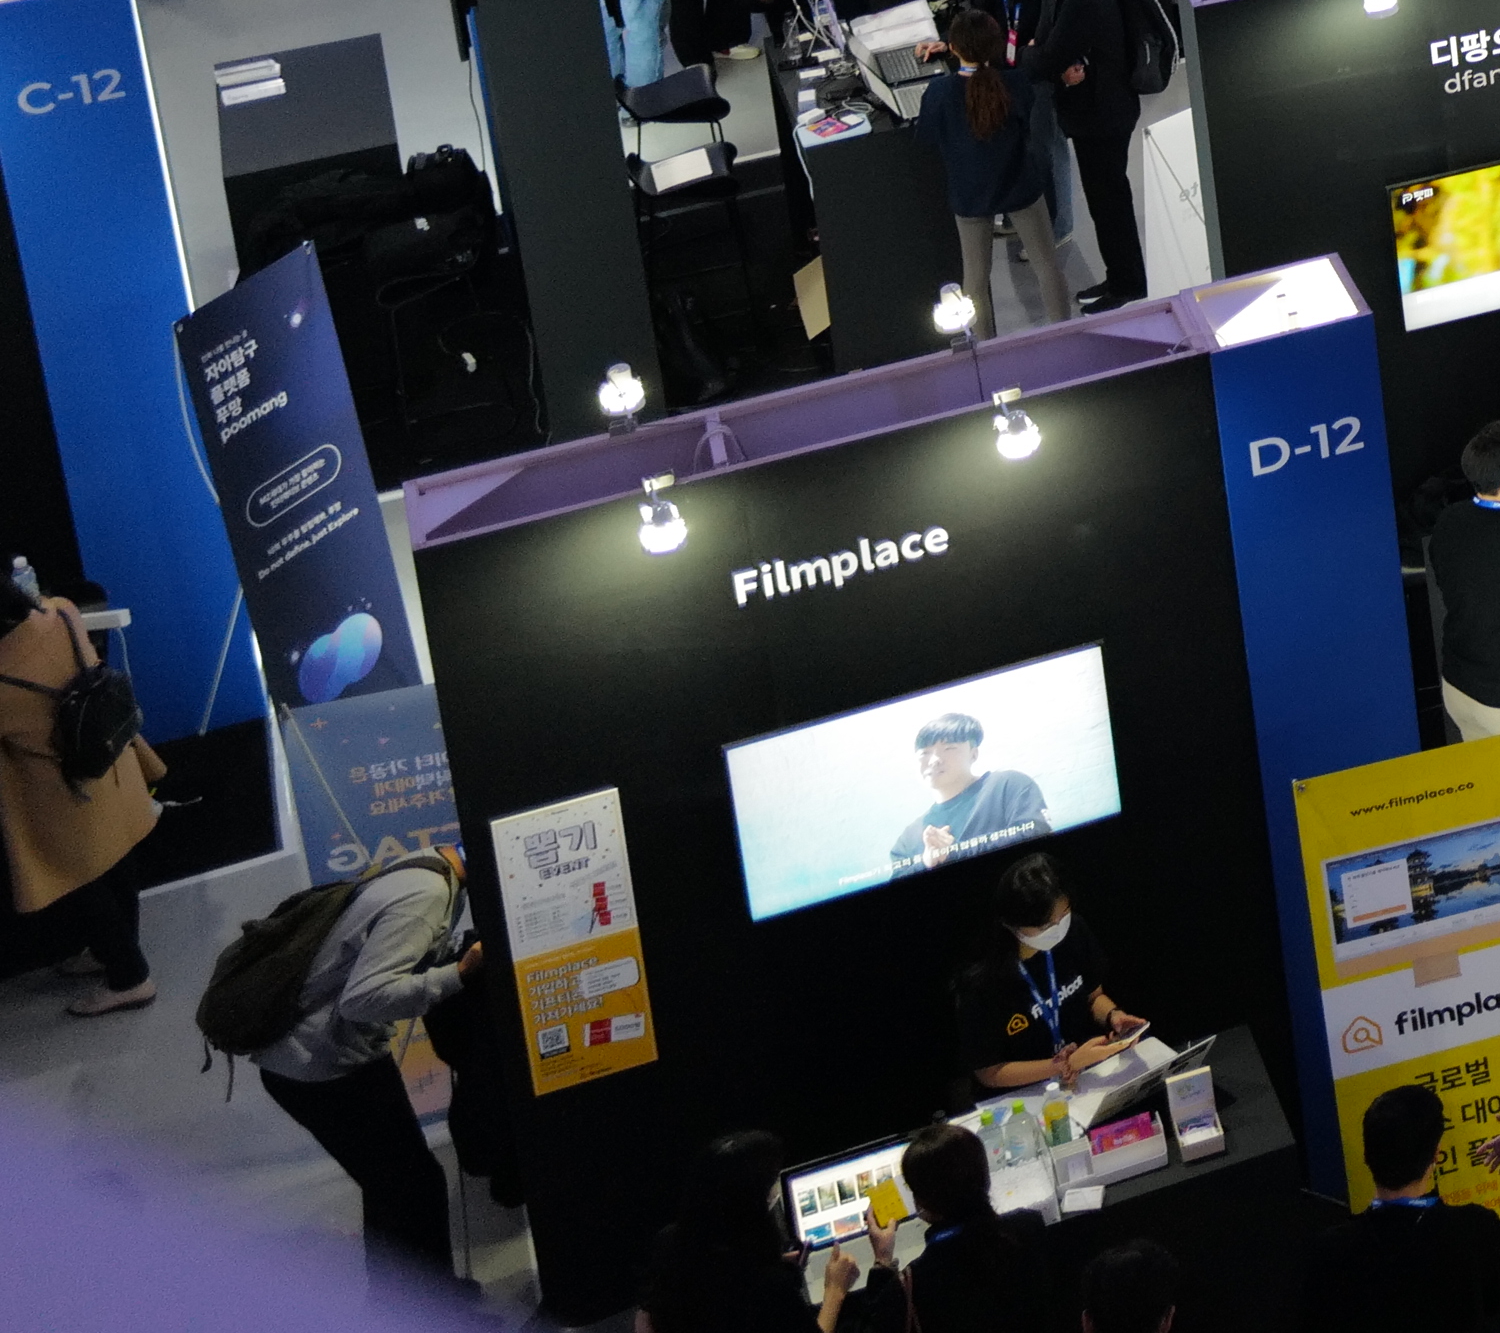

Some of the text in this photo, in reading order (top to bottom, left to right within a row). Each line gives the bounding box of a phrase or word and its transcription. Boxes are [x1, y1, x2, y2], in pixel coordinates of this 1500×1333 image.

[17, 68, 127, 115] C-12
[204, 337, 259, 383] 자아탐구
[220, 390, 289, 446] poomang
[1247, 416, 1366, 477] D-12
[732, 525, 951, 608] Filmplace
[1350, 781, 1475, 819] www.filmplace.co
[523, 820, 598, 870] 뽑기
[539, 856, 591, 881] EVENT
[526, 956, 598, 984] Filmplace
